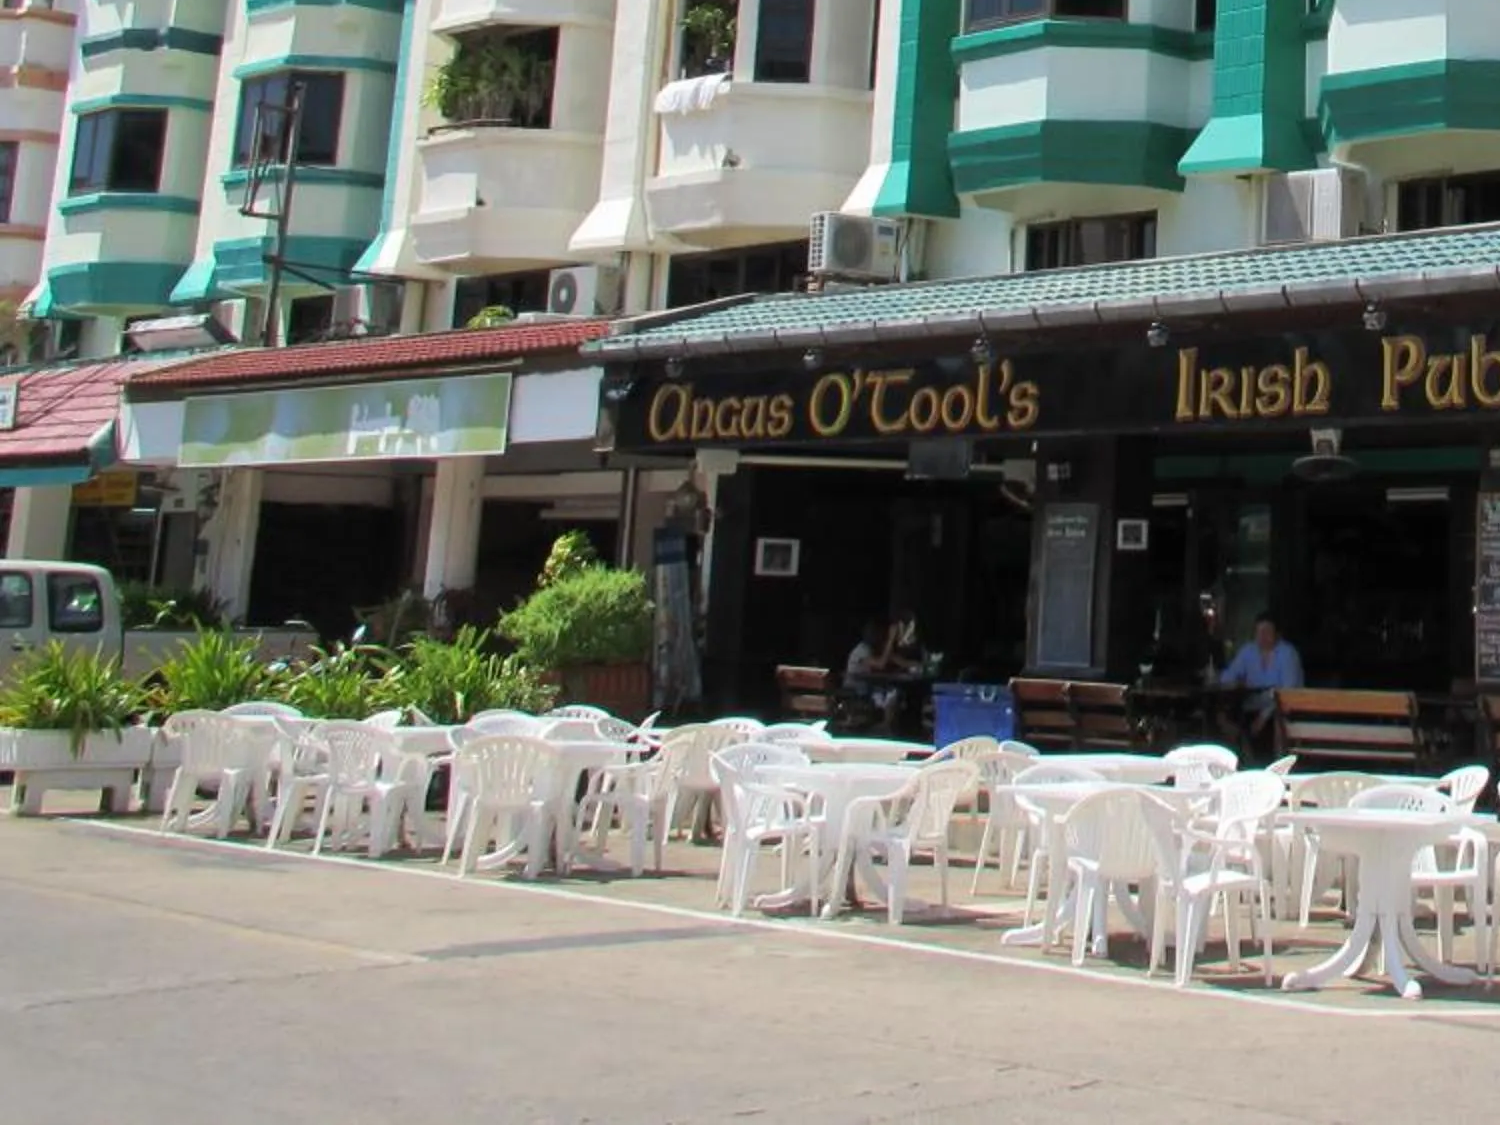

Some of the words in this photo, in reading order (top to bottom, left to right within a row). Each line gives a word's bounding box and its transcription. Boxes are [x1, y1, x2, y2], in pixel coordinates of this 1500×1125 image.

[648, 381, 794, 442] Angus
[809, 358, 1041, 435] O'Tool's
[1175, 346, 1332, 422] Irish
